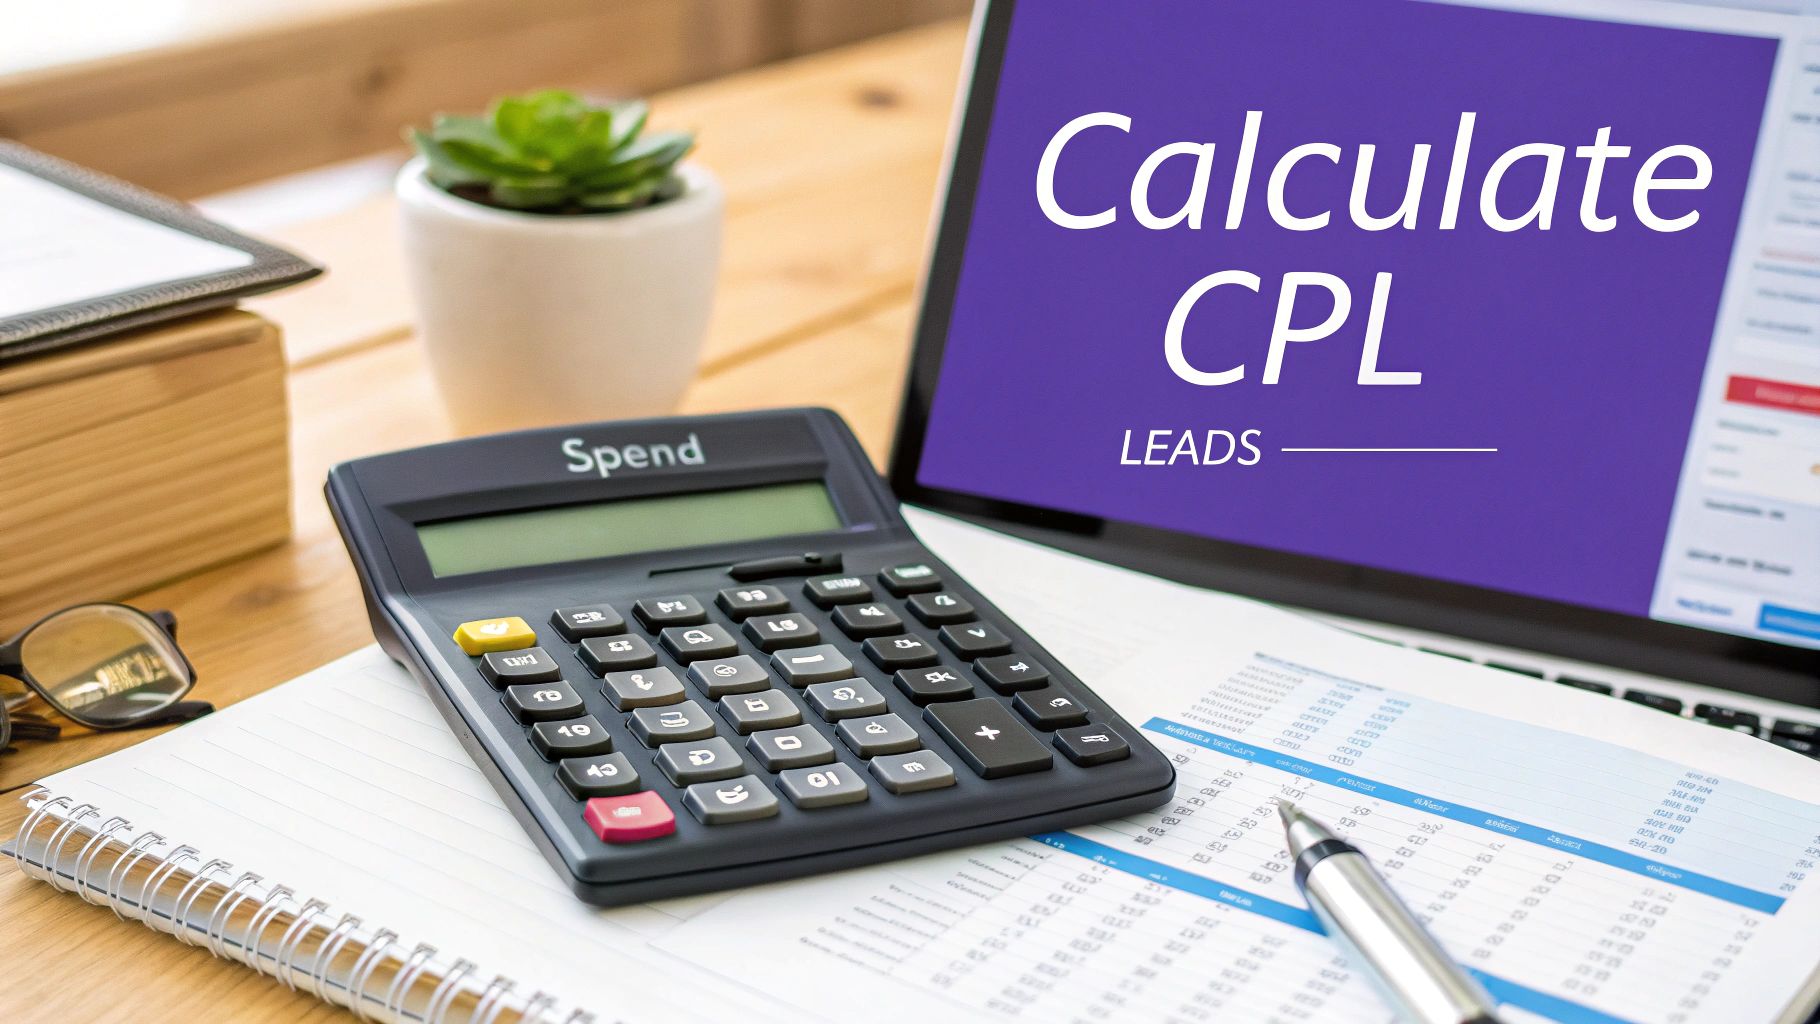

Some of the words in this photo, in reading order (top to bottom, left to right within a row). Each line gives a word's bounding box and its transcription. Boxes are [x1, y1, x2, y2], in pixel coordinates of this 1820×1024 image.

[1035, 110, 1713, 233] Calculate
[1163, 270, 1423, 386] CPL
[562, 433, 706, 478] Spend
[1120, 428, 1262, 467] LEADS
